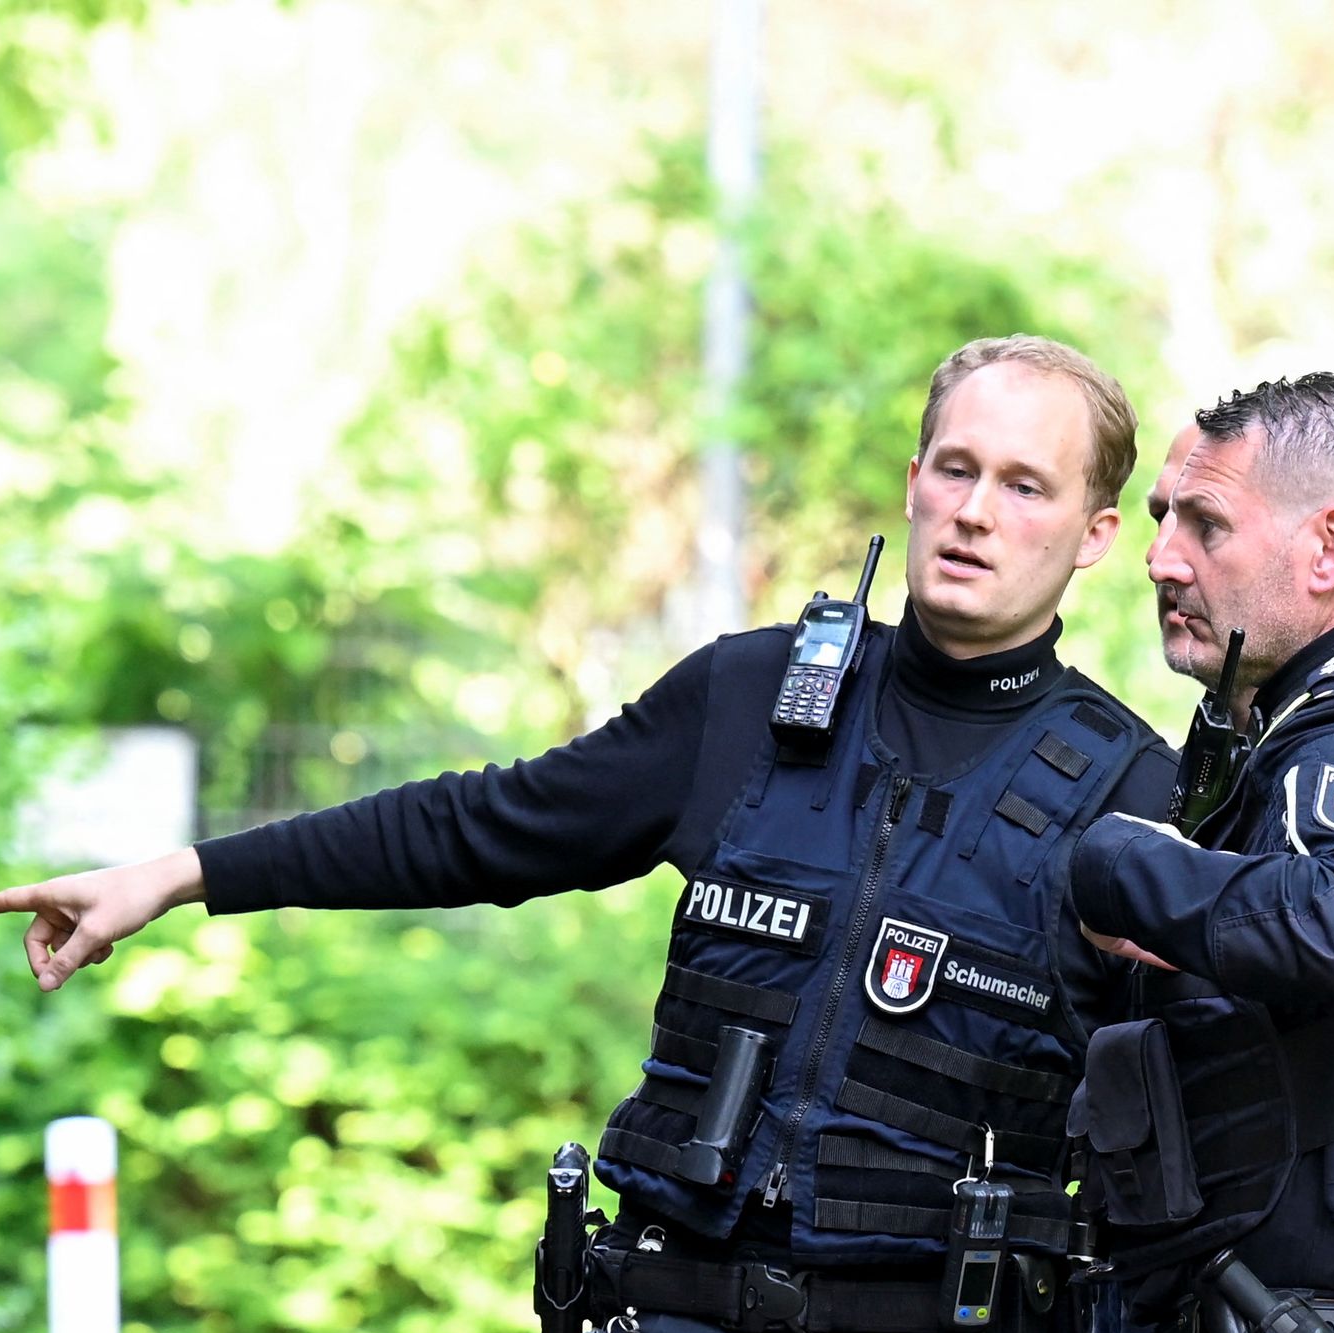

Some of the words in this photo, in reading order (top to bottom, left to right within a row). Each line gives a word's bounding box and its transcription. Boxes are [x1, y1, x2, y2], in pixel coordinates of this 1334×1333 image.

[990, 666, 1040, 692] POLIZEI
[685, 880, 810, 939] POLIZEI
[885, 927, 939, 954] POLIZEI
[943, 959, 1051, 1010] Schumacher
